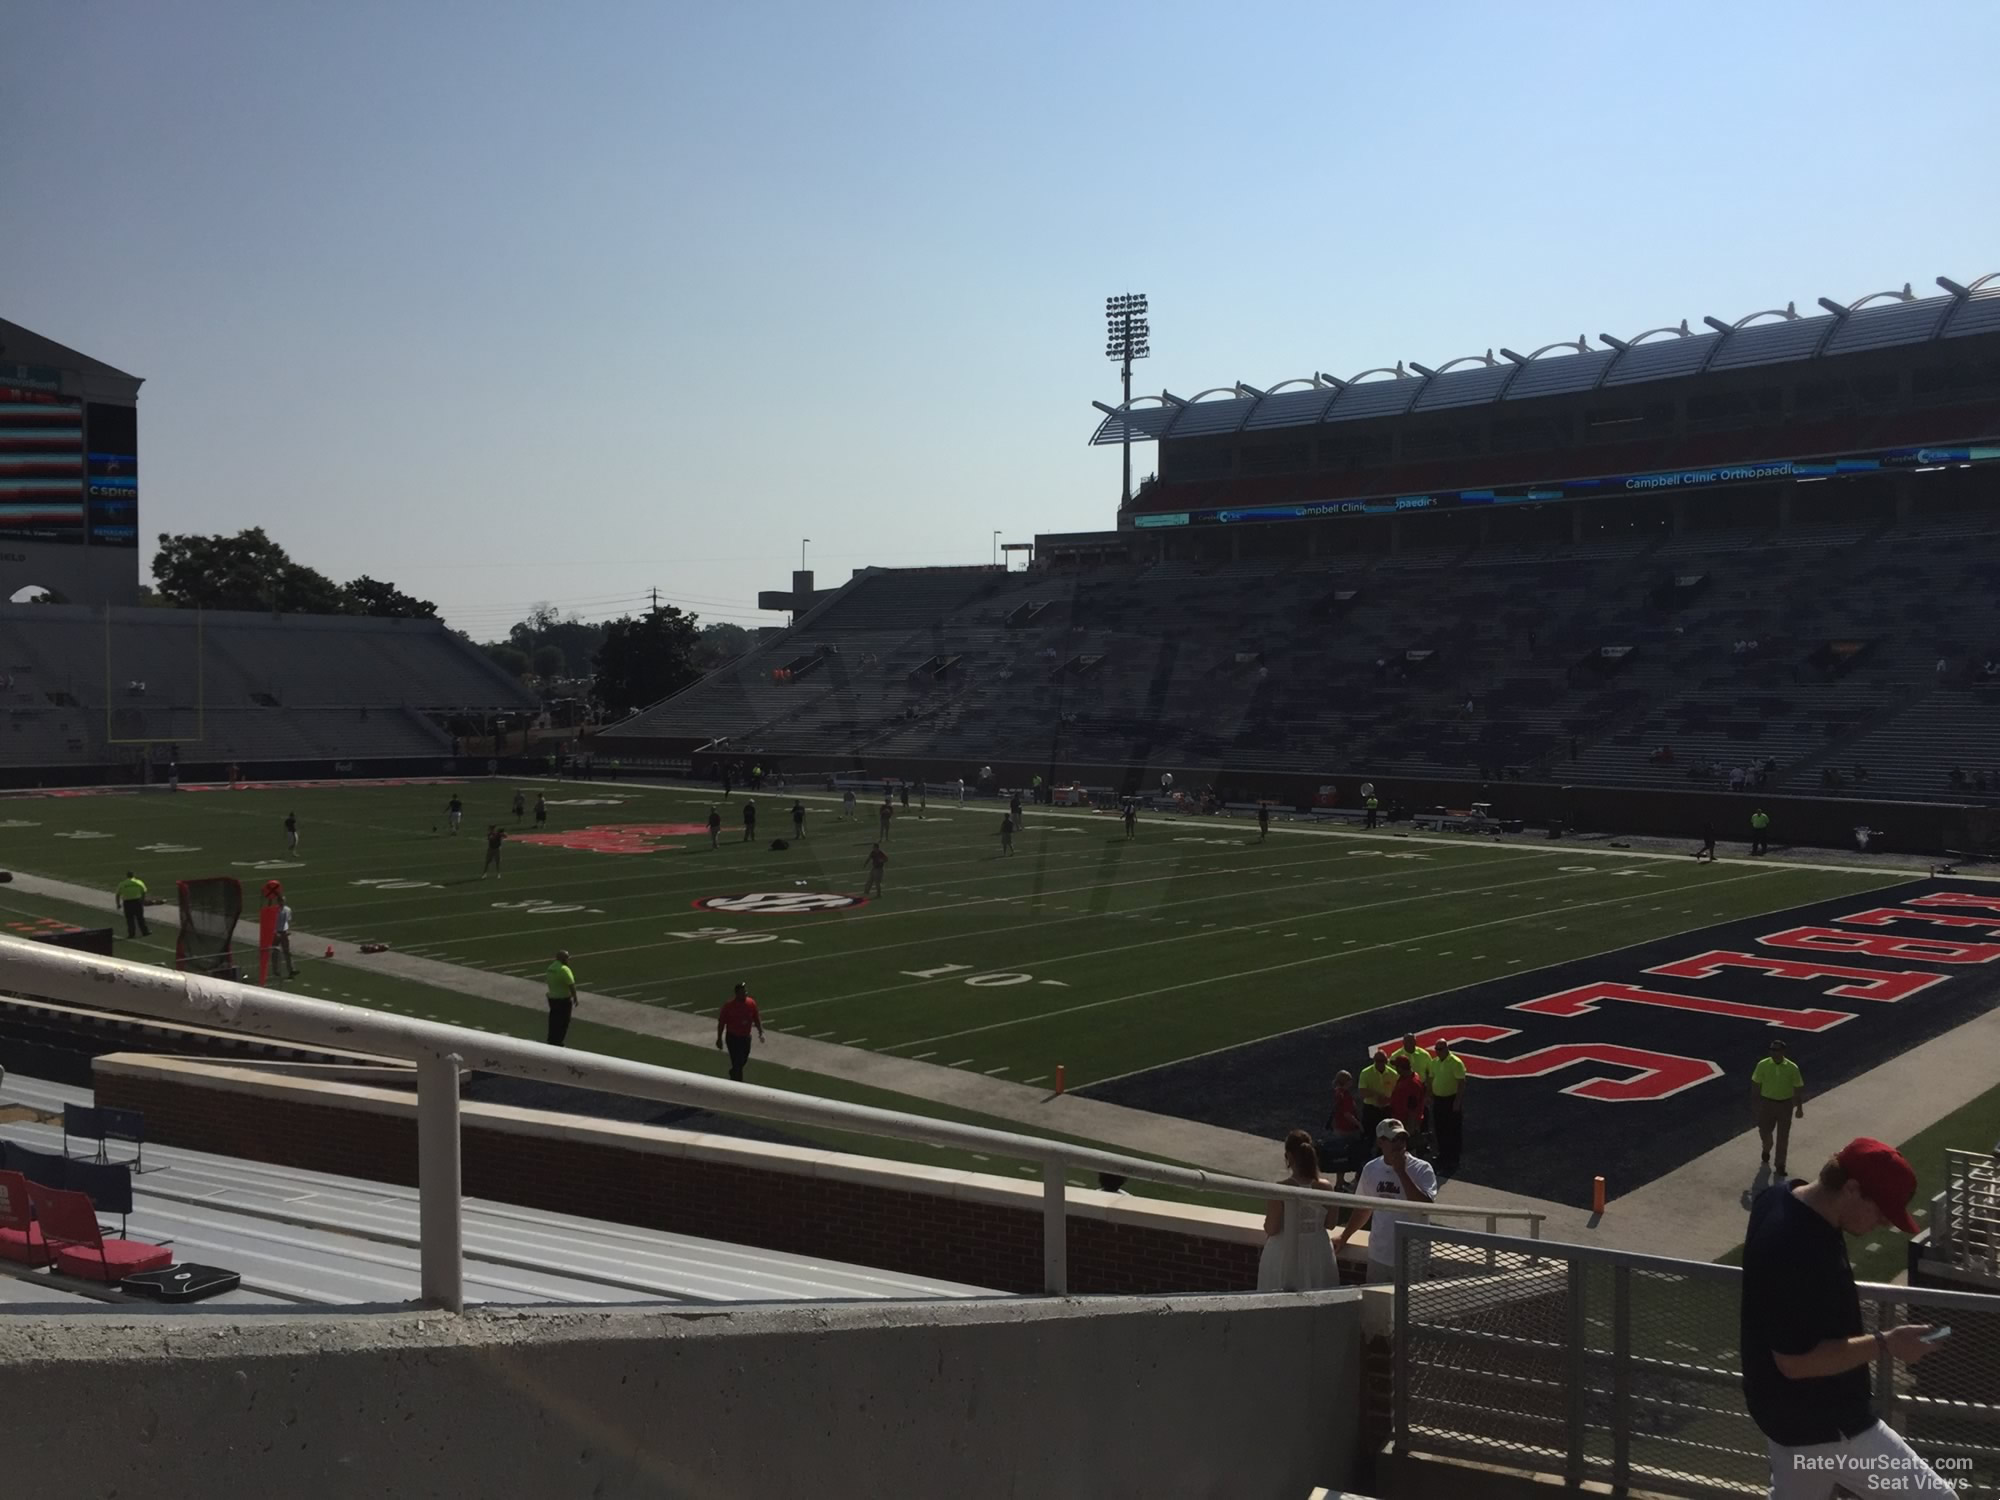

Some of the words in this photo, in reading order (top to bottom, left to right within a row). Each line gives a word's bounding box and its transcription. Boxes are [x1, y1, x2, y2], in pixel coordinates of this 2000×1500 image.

[1625, 475, 1681, 490] Campbell
[1683, 471, 1718, 484] Clinic
[89, 485, 99, 495] C
[100, 486, 137, 498] spire
[1295, 502, 1339, 517] Campbell
[663, 925, 781, 946] 20
[898, 963, 1033, 987] 10
